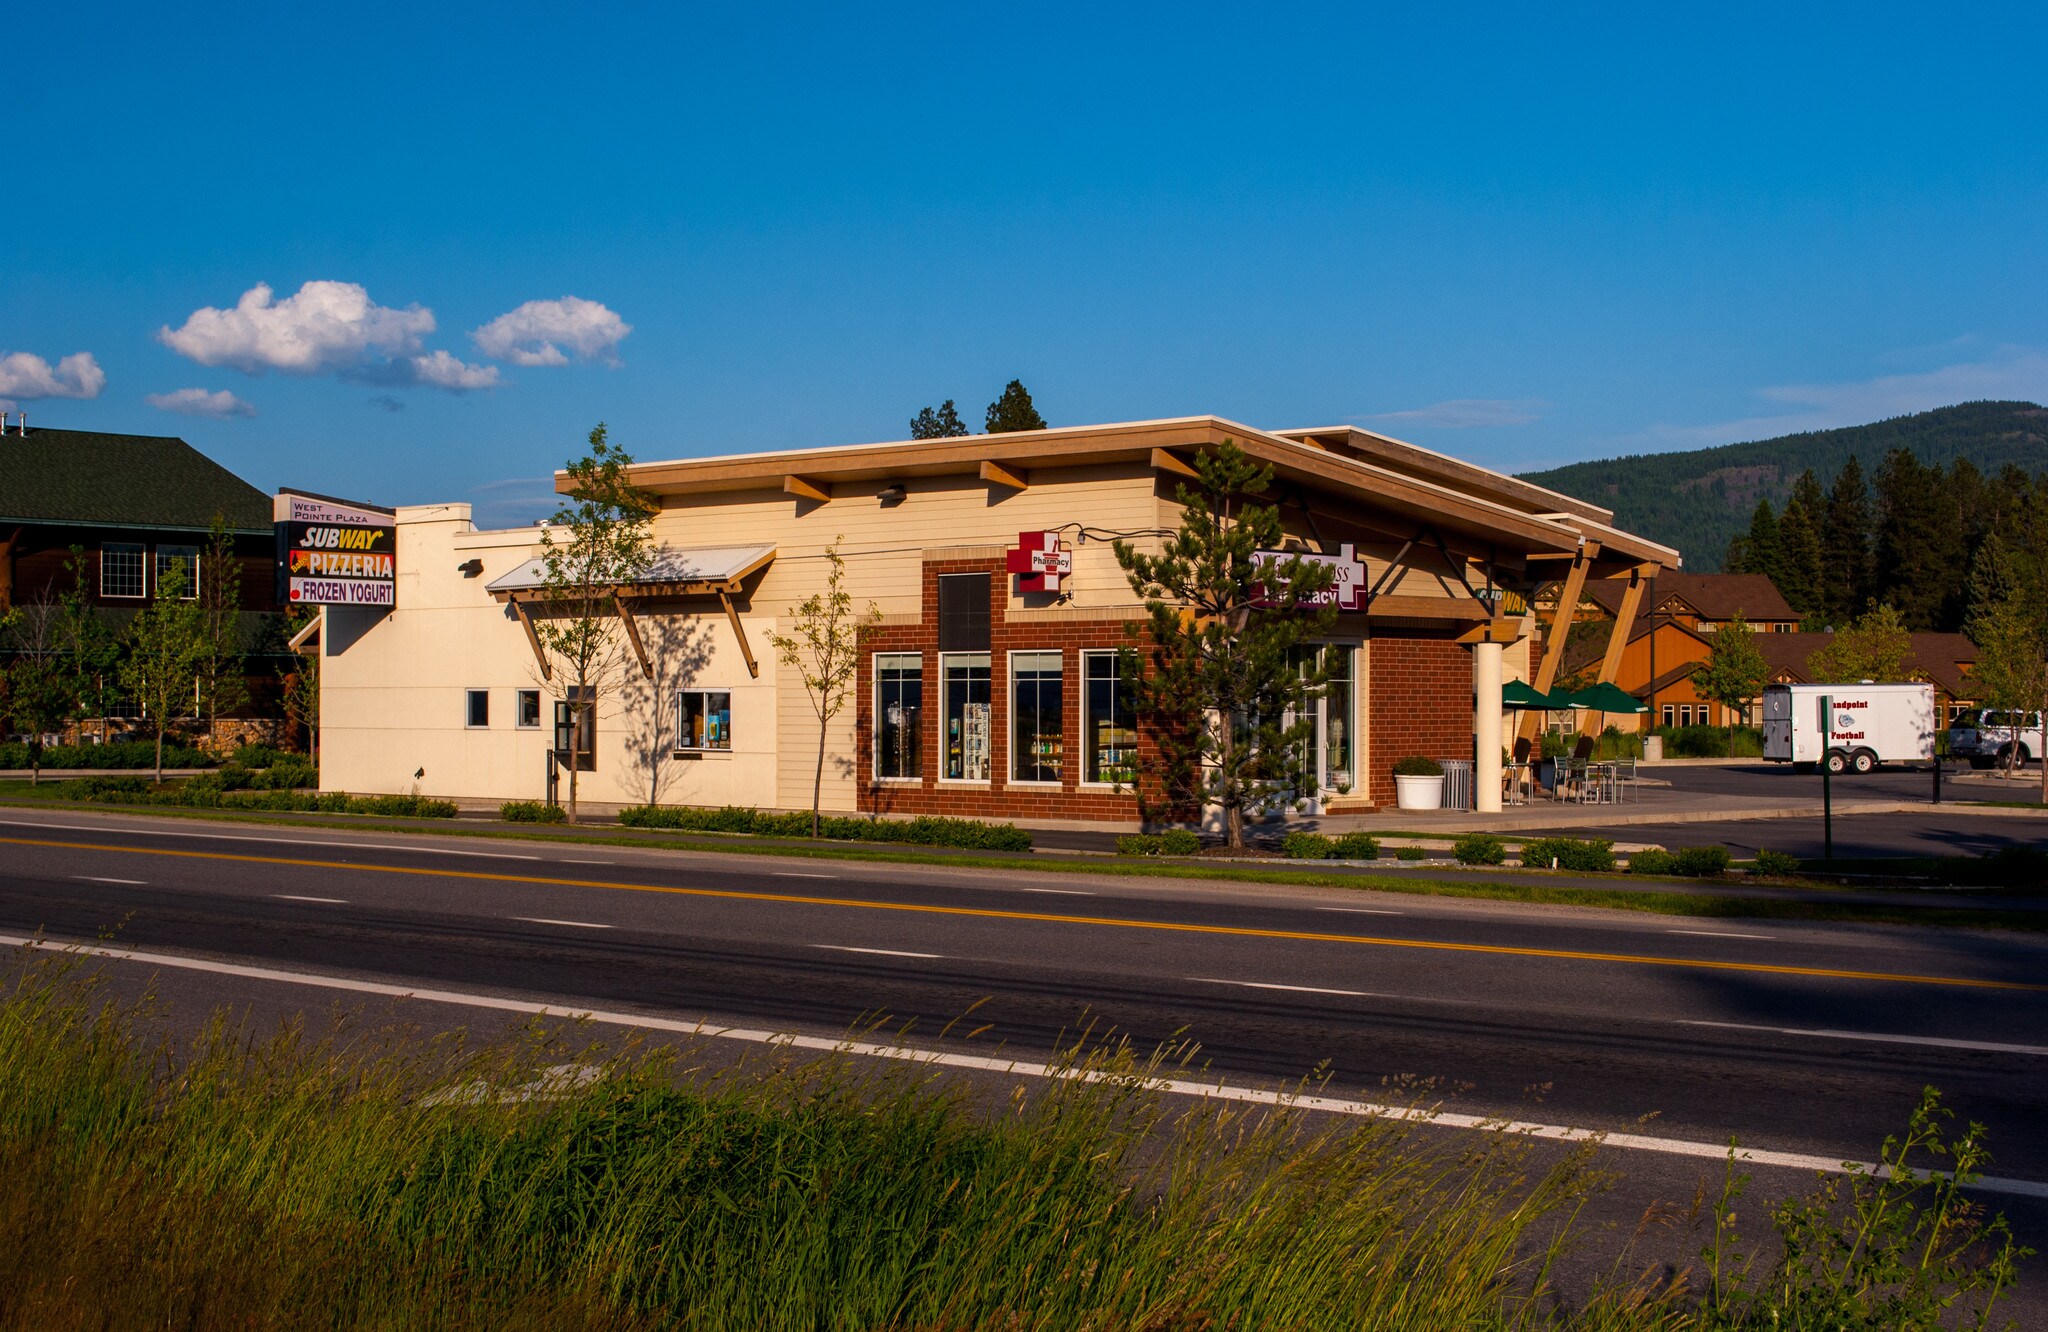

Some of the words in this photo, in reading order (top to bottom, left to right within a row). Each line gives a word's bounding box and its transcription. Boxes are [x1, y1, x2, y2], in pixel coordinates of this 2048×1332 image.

[294, 503, 323, 512] WEST
[294, 512, 332, 521] POINTE
[336, 514, 368, 523] PLAZA
[300, 527, 384, 550] SUBWAY
[309, 553, 394, 578] PIZZERIA
[1033, 556, 1069, 568] Pharmacy
[303, 581, 347, 601] FROZEN
[349, 583, 392, 603] YOGURT
[1833, 701, 1868, 710] andpoint
